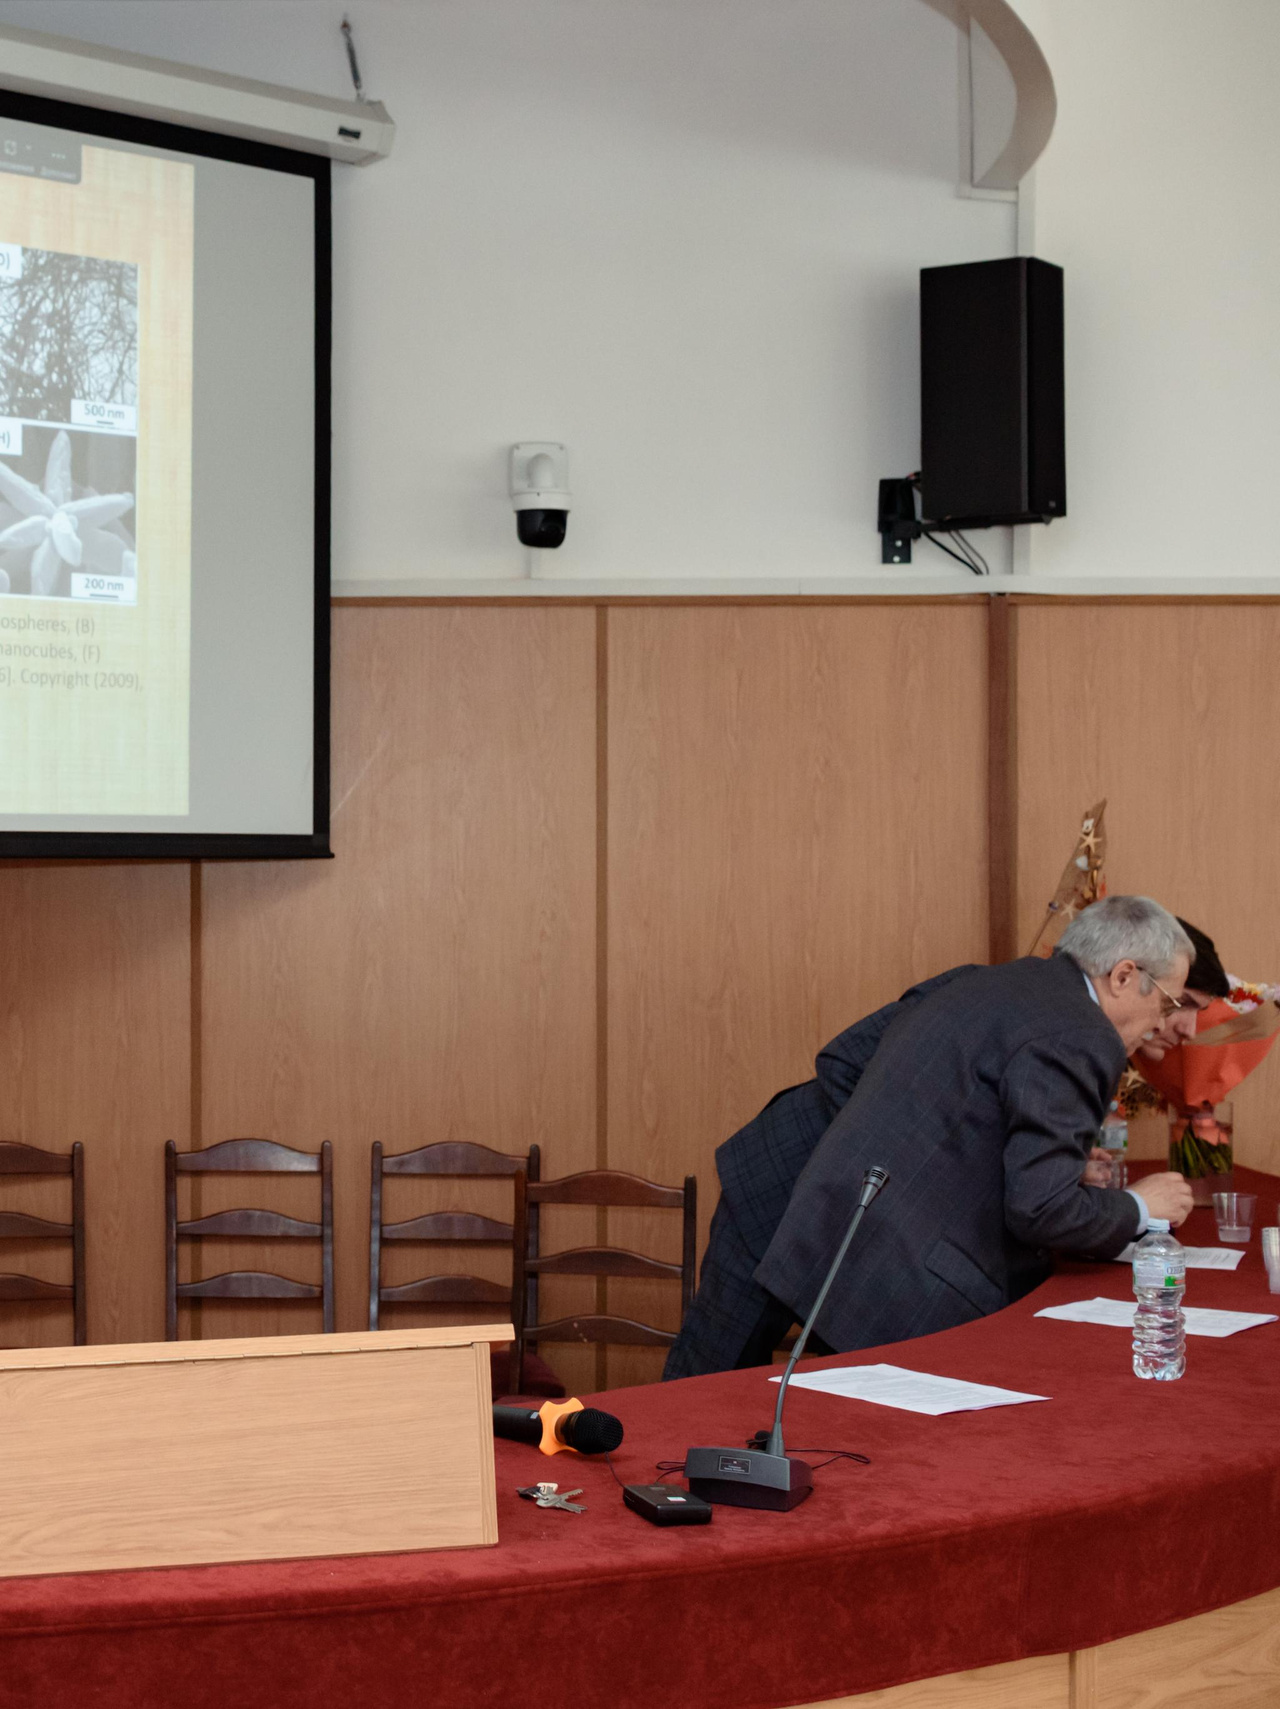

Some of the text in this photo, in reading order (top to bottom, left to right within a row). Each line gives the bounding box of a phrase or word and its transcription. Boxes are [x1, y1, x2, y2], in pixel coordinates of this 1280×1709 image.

[83, 403, 126, 421] 500 nm
[83, 576, 125, 592] 200 nm
[75, 618, 96, 636] (B)
[82, 644, 102, 663] (F)
[20, 667, 90, 690] Copyright
